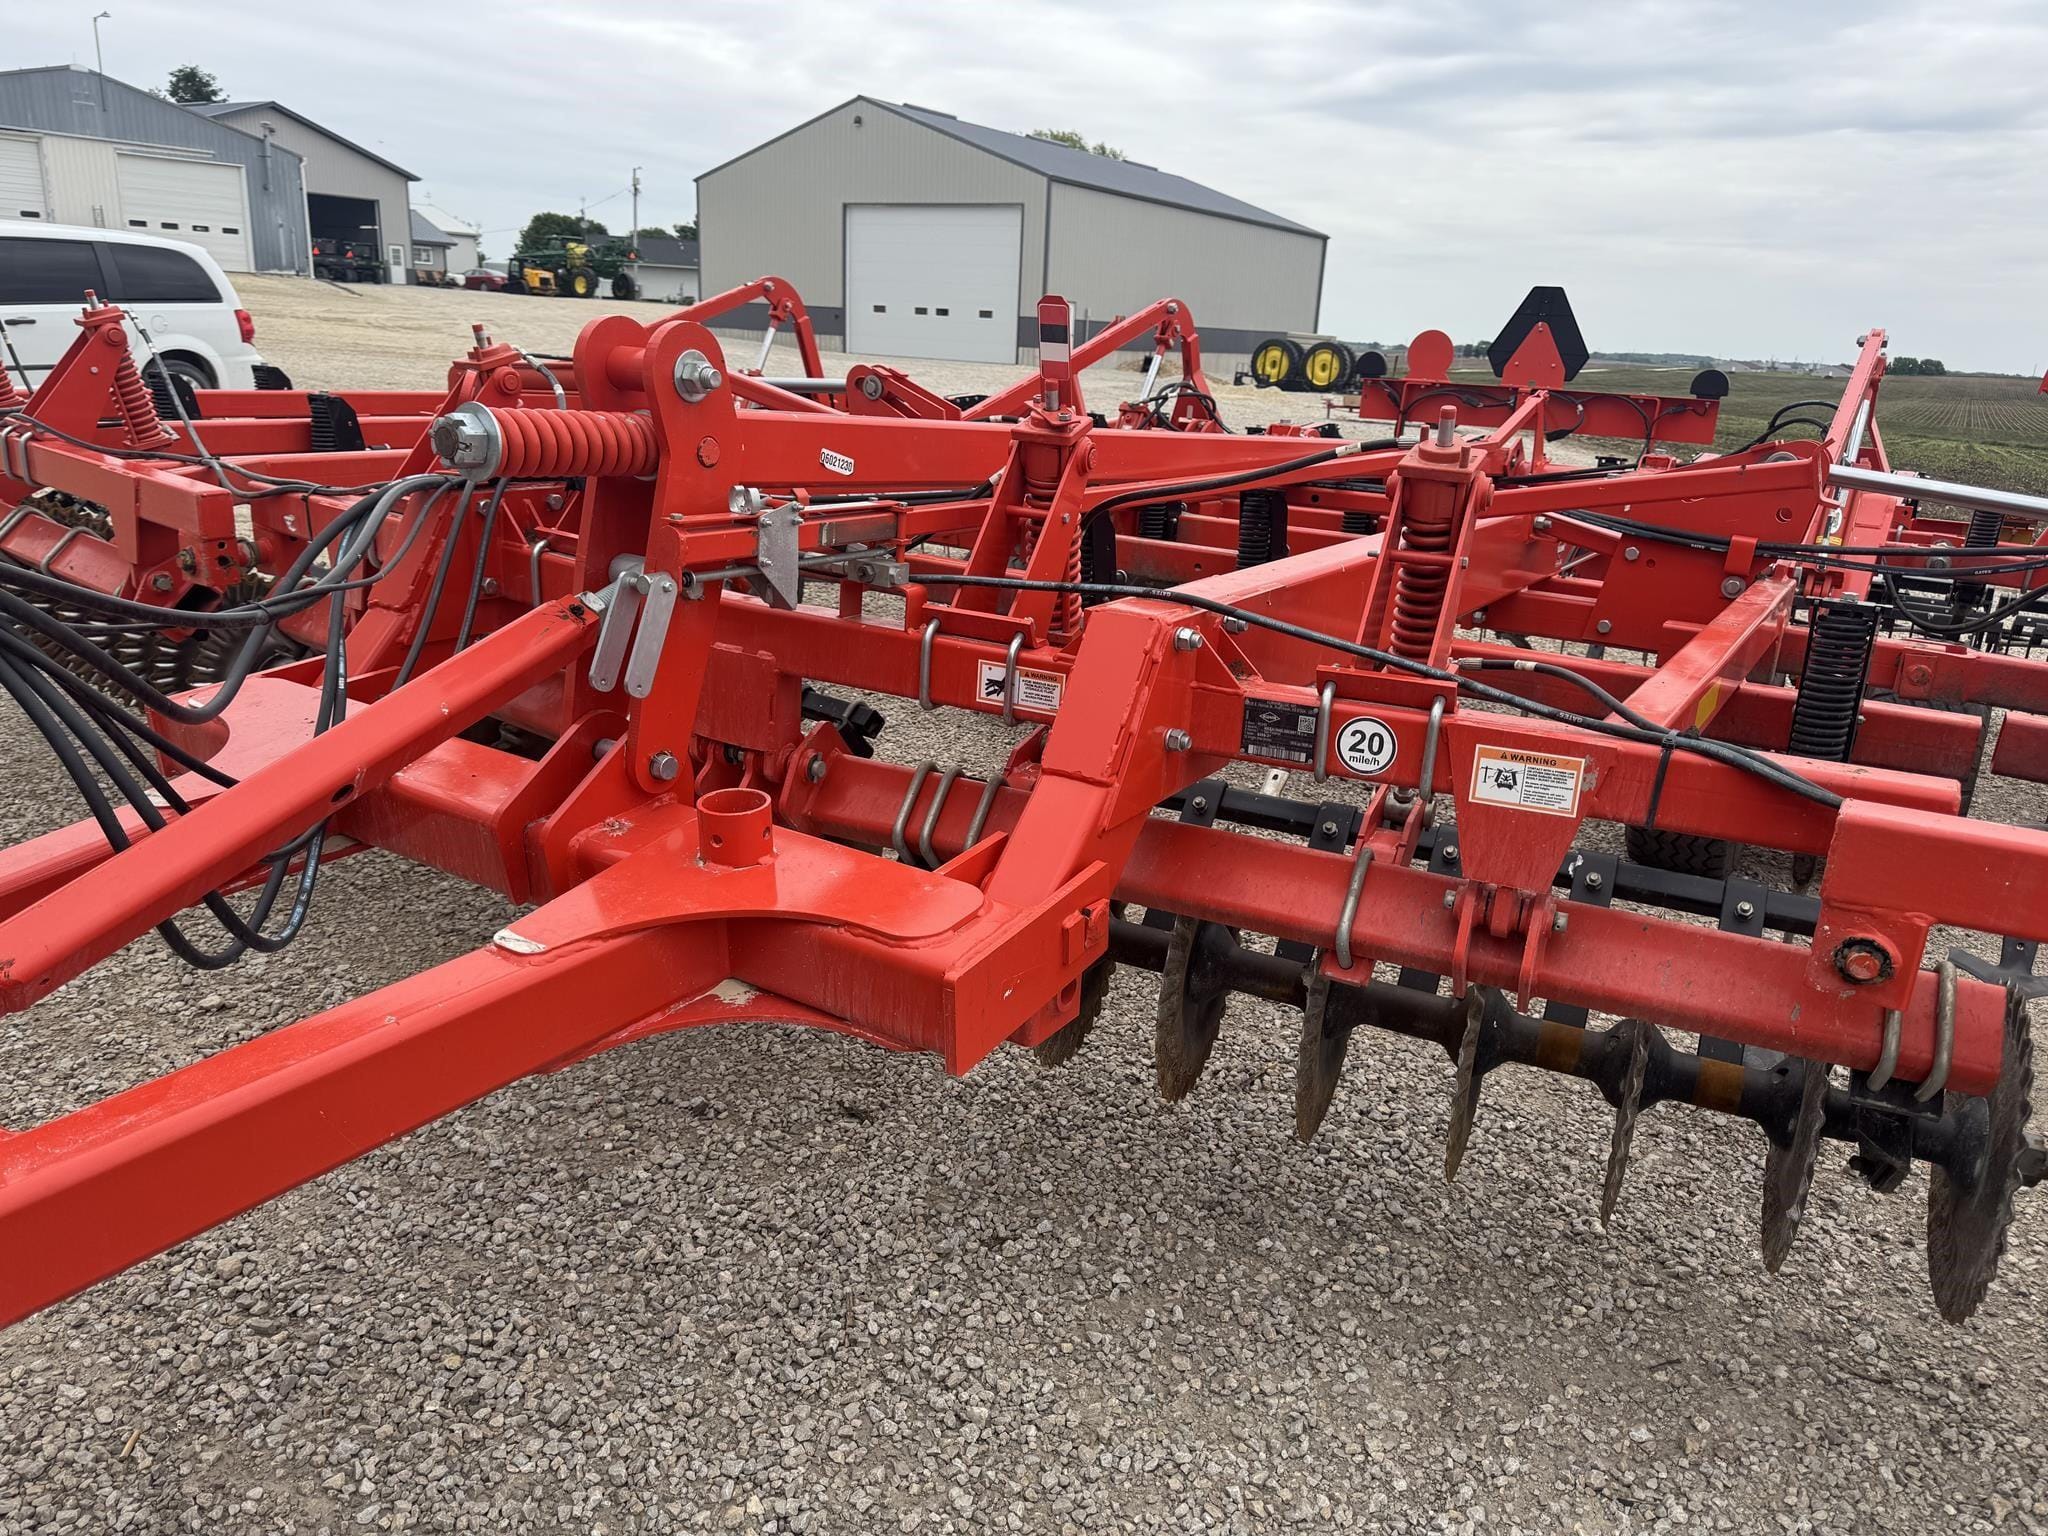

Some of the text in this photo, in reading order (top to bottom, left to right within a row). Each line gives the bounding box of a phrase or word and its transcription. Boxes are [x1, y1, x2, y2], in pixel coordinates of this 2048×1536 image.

[1031, 672, 1058, 682] WARNING
[1559, 712, 1583, 723] GATES
[1348, 730, 1384, 756] 20
[1348, 755, 1380, 766] mile/h
[1510, 753, 1557, 766] WARNING
